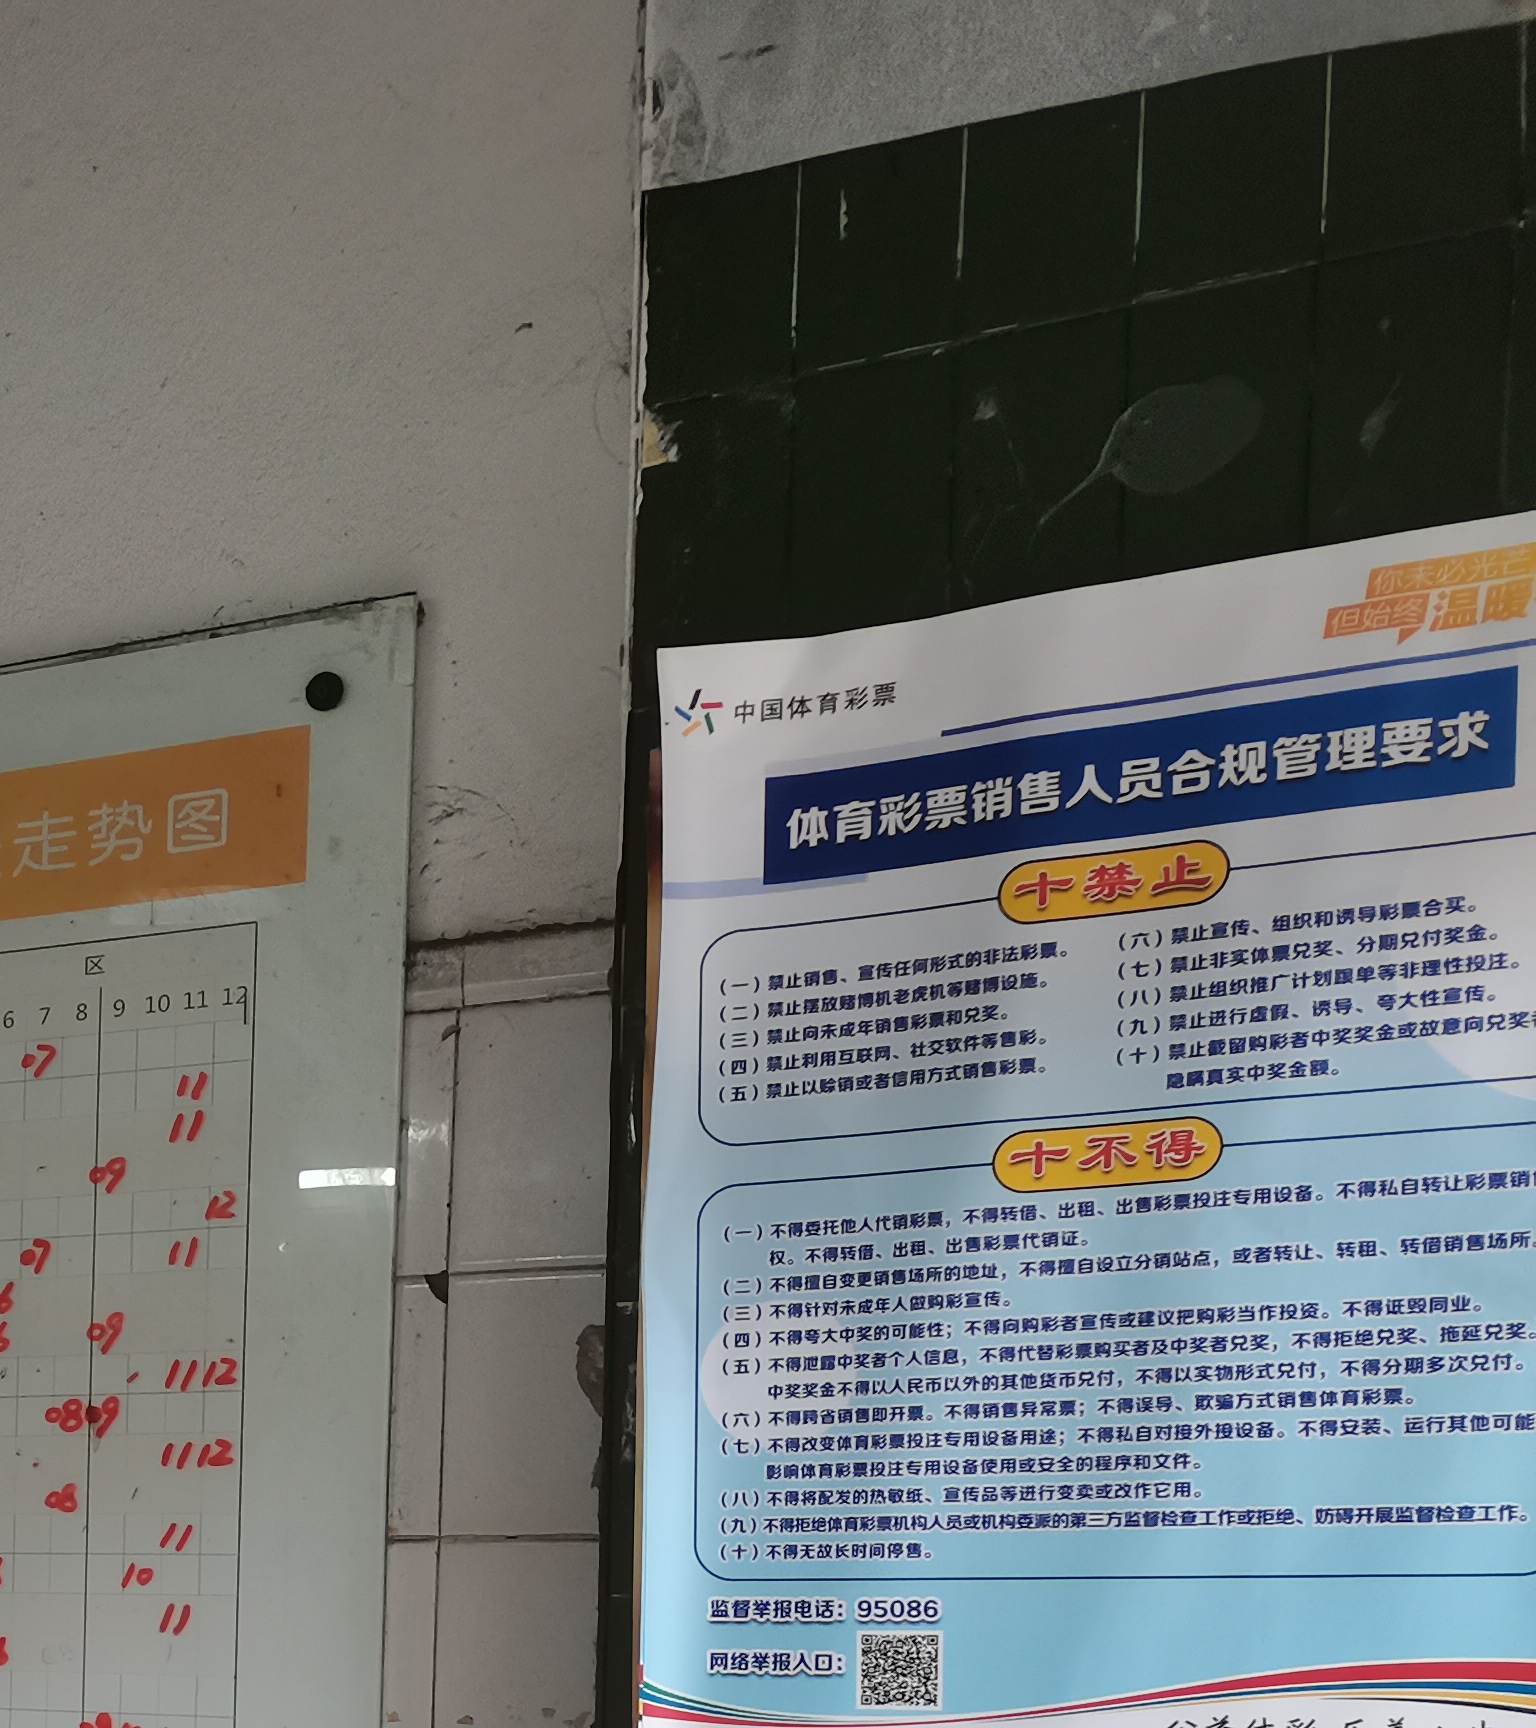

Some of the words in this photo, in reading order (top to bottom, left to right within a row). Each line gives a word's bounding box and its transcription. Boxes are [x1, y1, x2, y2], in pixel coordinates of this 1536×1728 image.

[733, 680, 899, 726] 中国体育彩票
[785, 710, 1492, 850] 体育彩票销售人员合规管理要求
[1012, 853, 1213, 911] 十禁止
[85, 955, 105, 975] 区
[3, 1011, 15, 1029] 6
[76, 1003, 88, 1021] 8
[145, 994, 170, 1014] 10
[183, 990, 209, 1009] 11
[21, 1043, 57, 1078] 07
[176, 1071, 207, 1100] 11
[1008, 1125, 1204, 1179] 十不得
[89, 1156, 126, 1193] 09
[205, 1190, 236, 1221] 12
[856, 1597, 940, 1621] 95086
